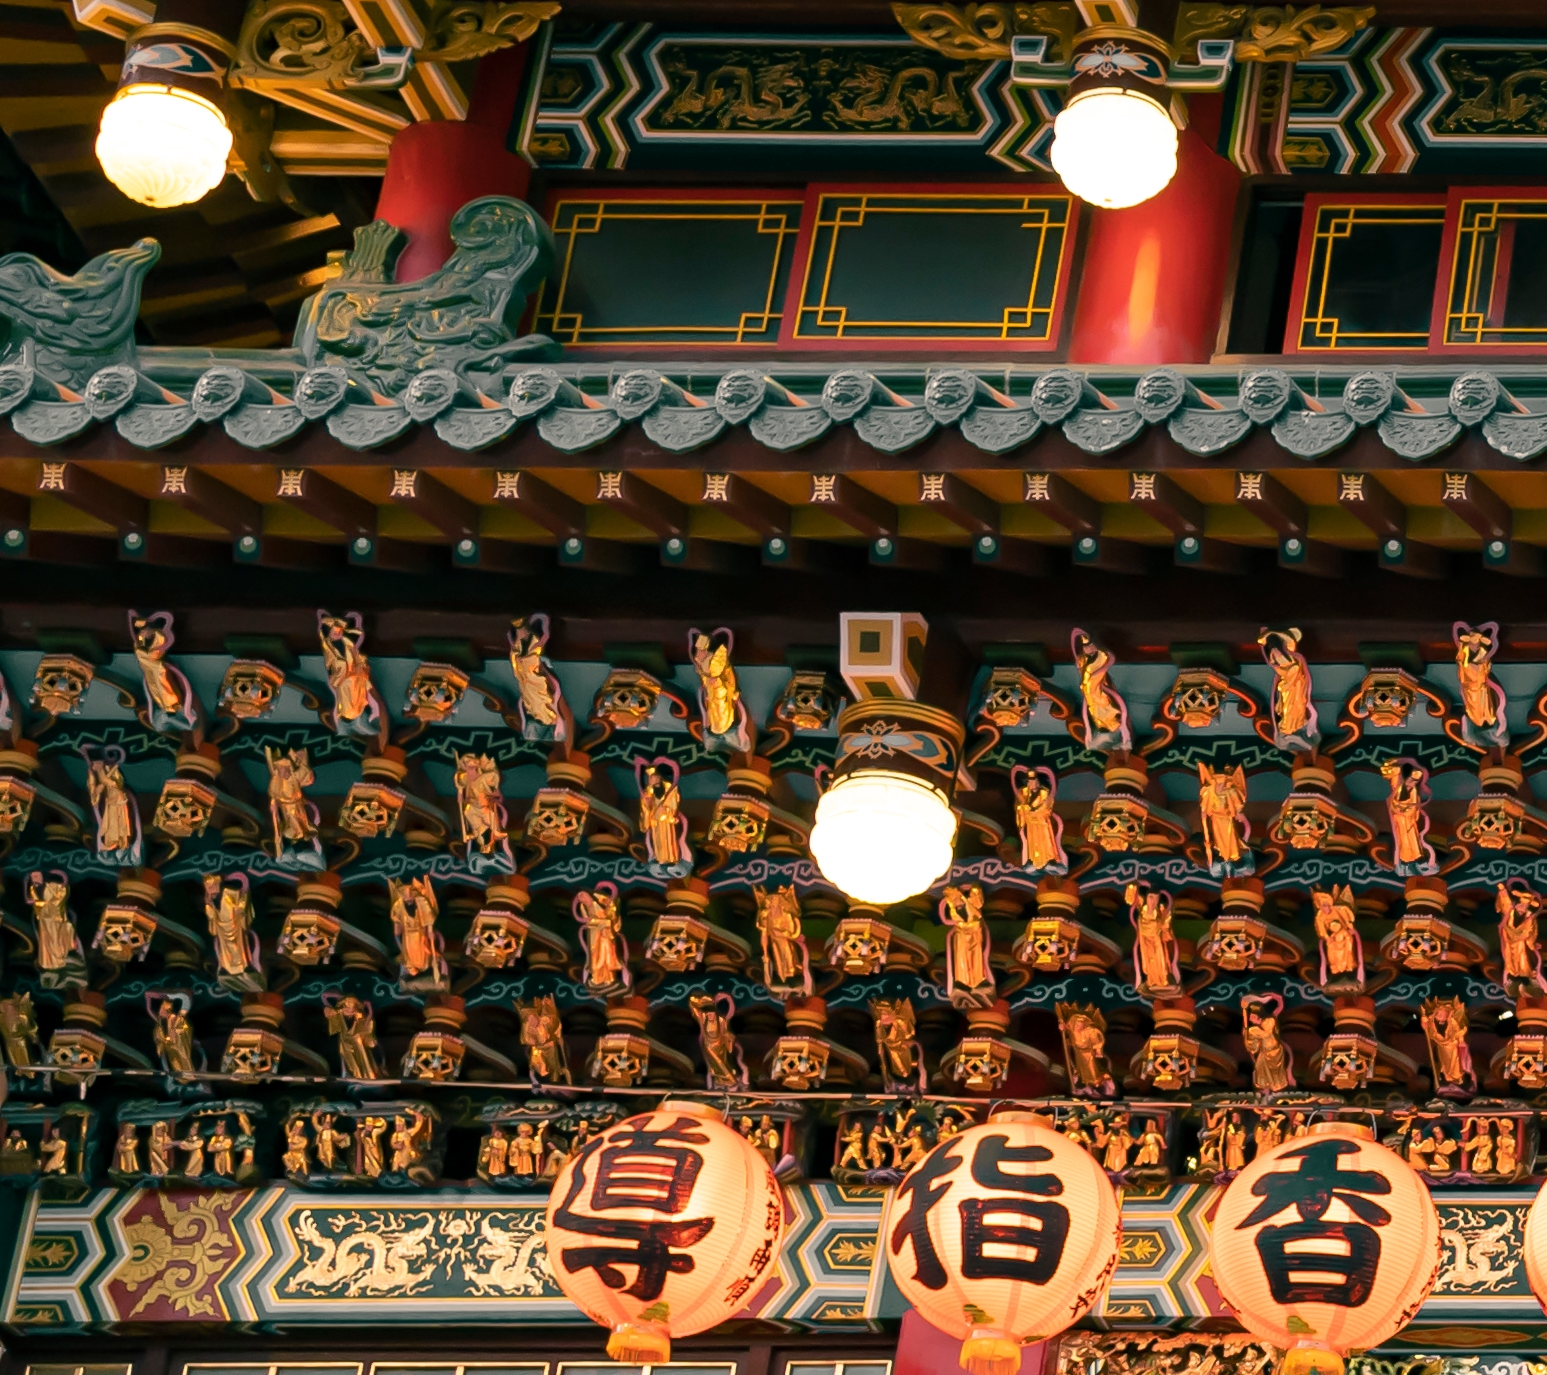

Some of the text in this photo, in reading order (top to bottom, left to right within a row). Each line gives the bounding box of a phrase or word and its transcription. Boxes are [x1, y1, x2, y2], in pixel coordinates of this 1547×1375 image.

[552, 1114, 716, 1302] 導
[892, 1133, 1071, 1291] 指
[1234, 1137, 1393, 1309] 香
